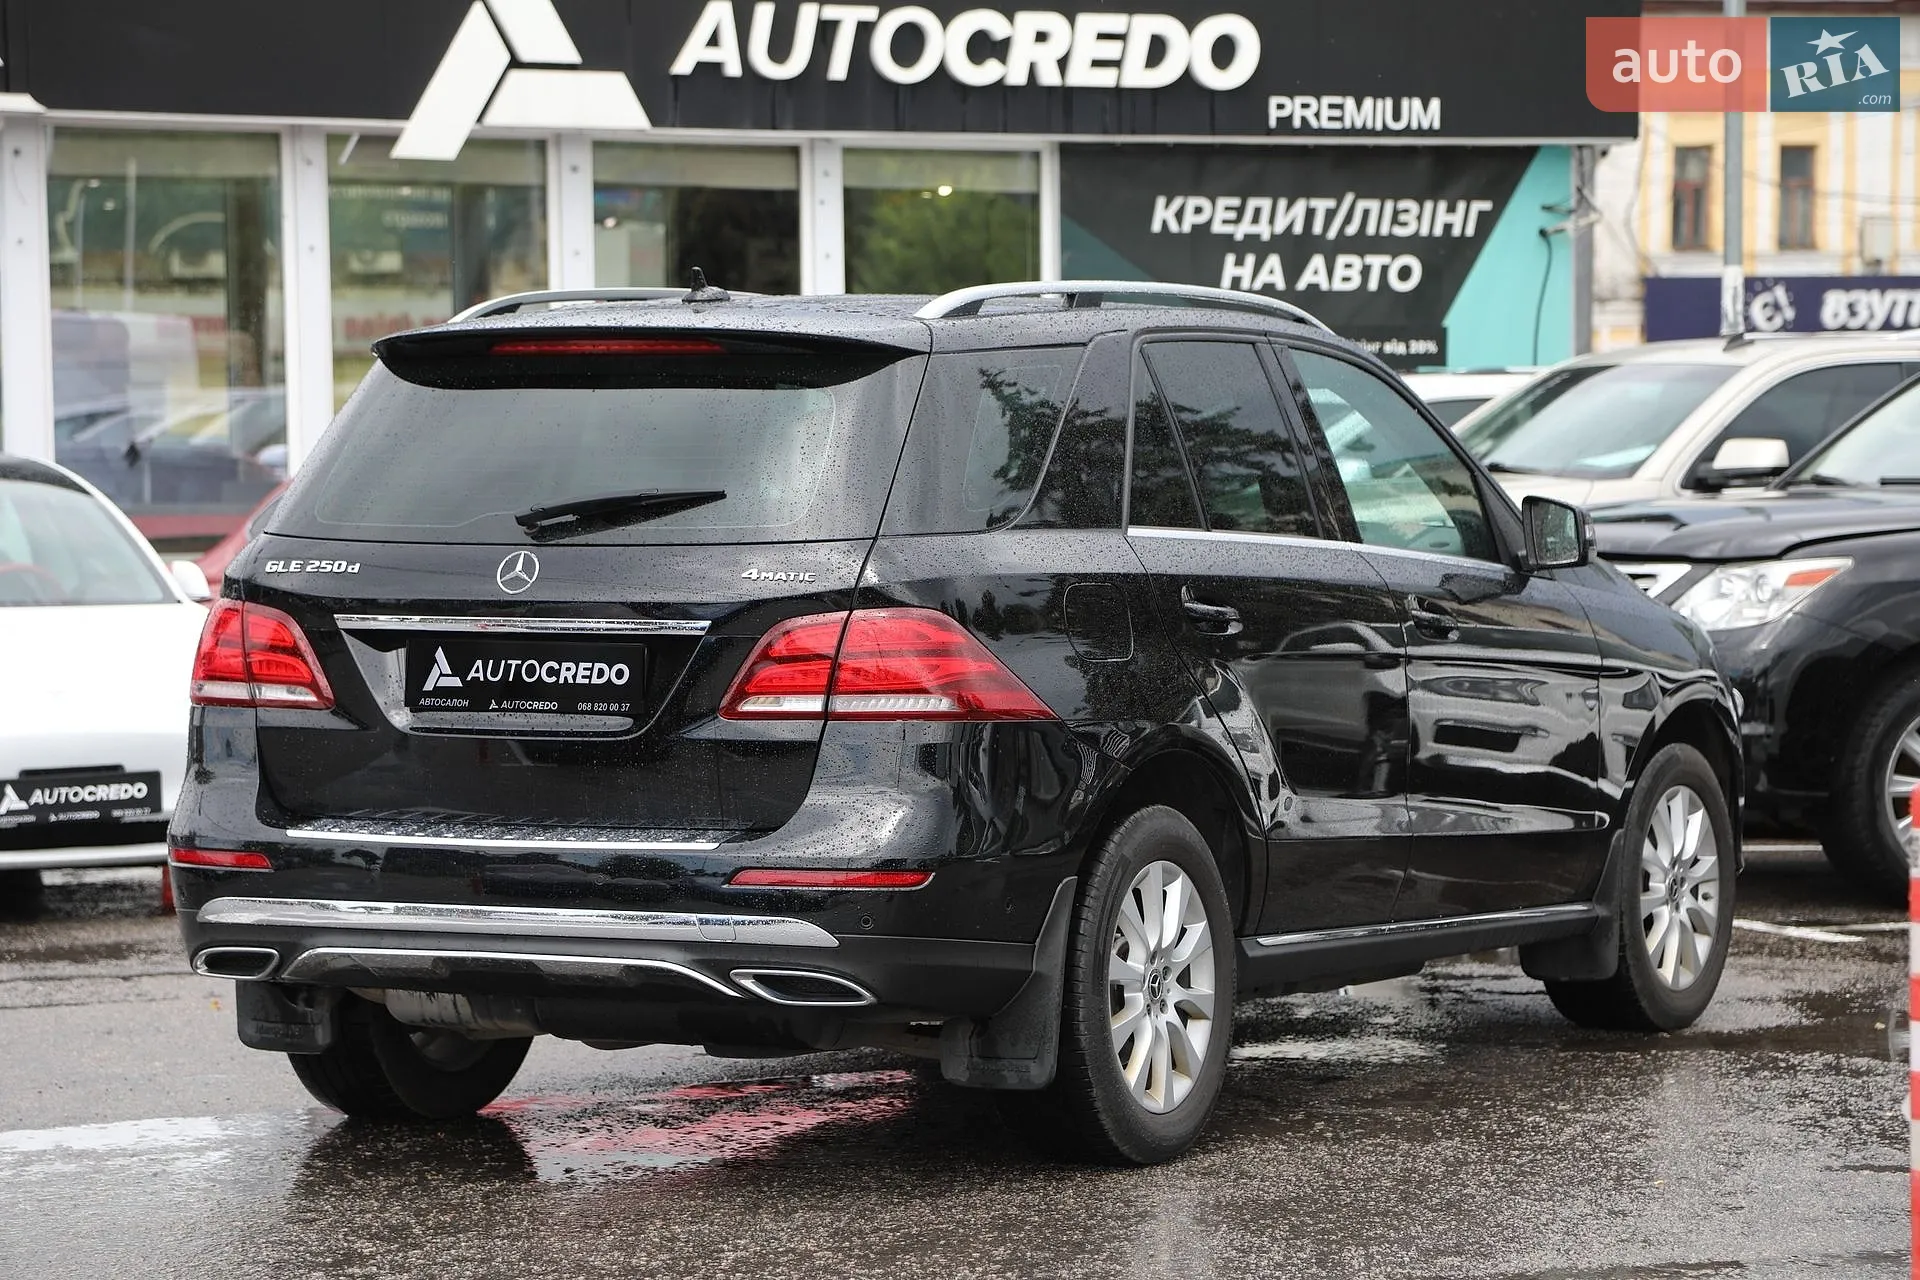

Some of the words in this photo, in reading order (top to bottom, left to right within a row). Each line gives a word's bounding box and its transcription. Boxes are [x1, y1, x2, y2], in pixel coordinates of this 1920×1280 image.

[669, 0, 1261, 91] AUTOCREDO
[1267, 95, 1442, 131] PREMIUM
[1151, 192, 1493, 241] КРЕДИТ/ЛІЗІНГ
[1219, 252, 1287, 291] НА
[1295, 253, 1423, 293] АВТО
[265, 560, 304, 573] GLE
[305, 560, 361, 574] 250d
[741, 568, 816, 583] 4MATIC
[465, 659, 631, 686] AUTOCREDO
[418, 698, 470, 708] АВТОСАЛОН
[500, 700, 558, 711] AUTOCREDO
[577, 702, 592, 712] 068
[593, 702, 608, 712] 820
[609, 702, 619, 712] 00
[620, 702, 631, 712] 37
[28, 781, 149, 807] AUTOCREDO
